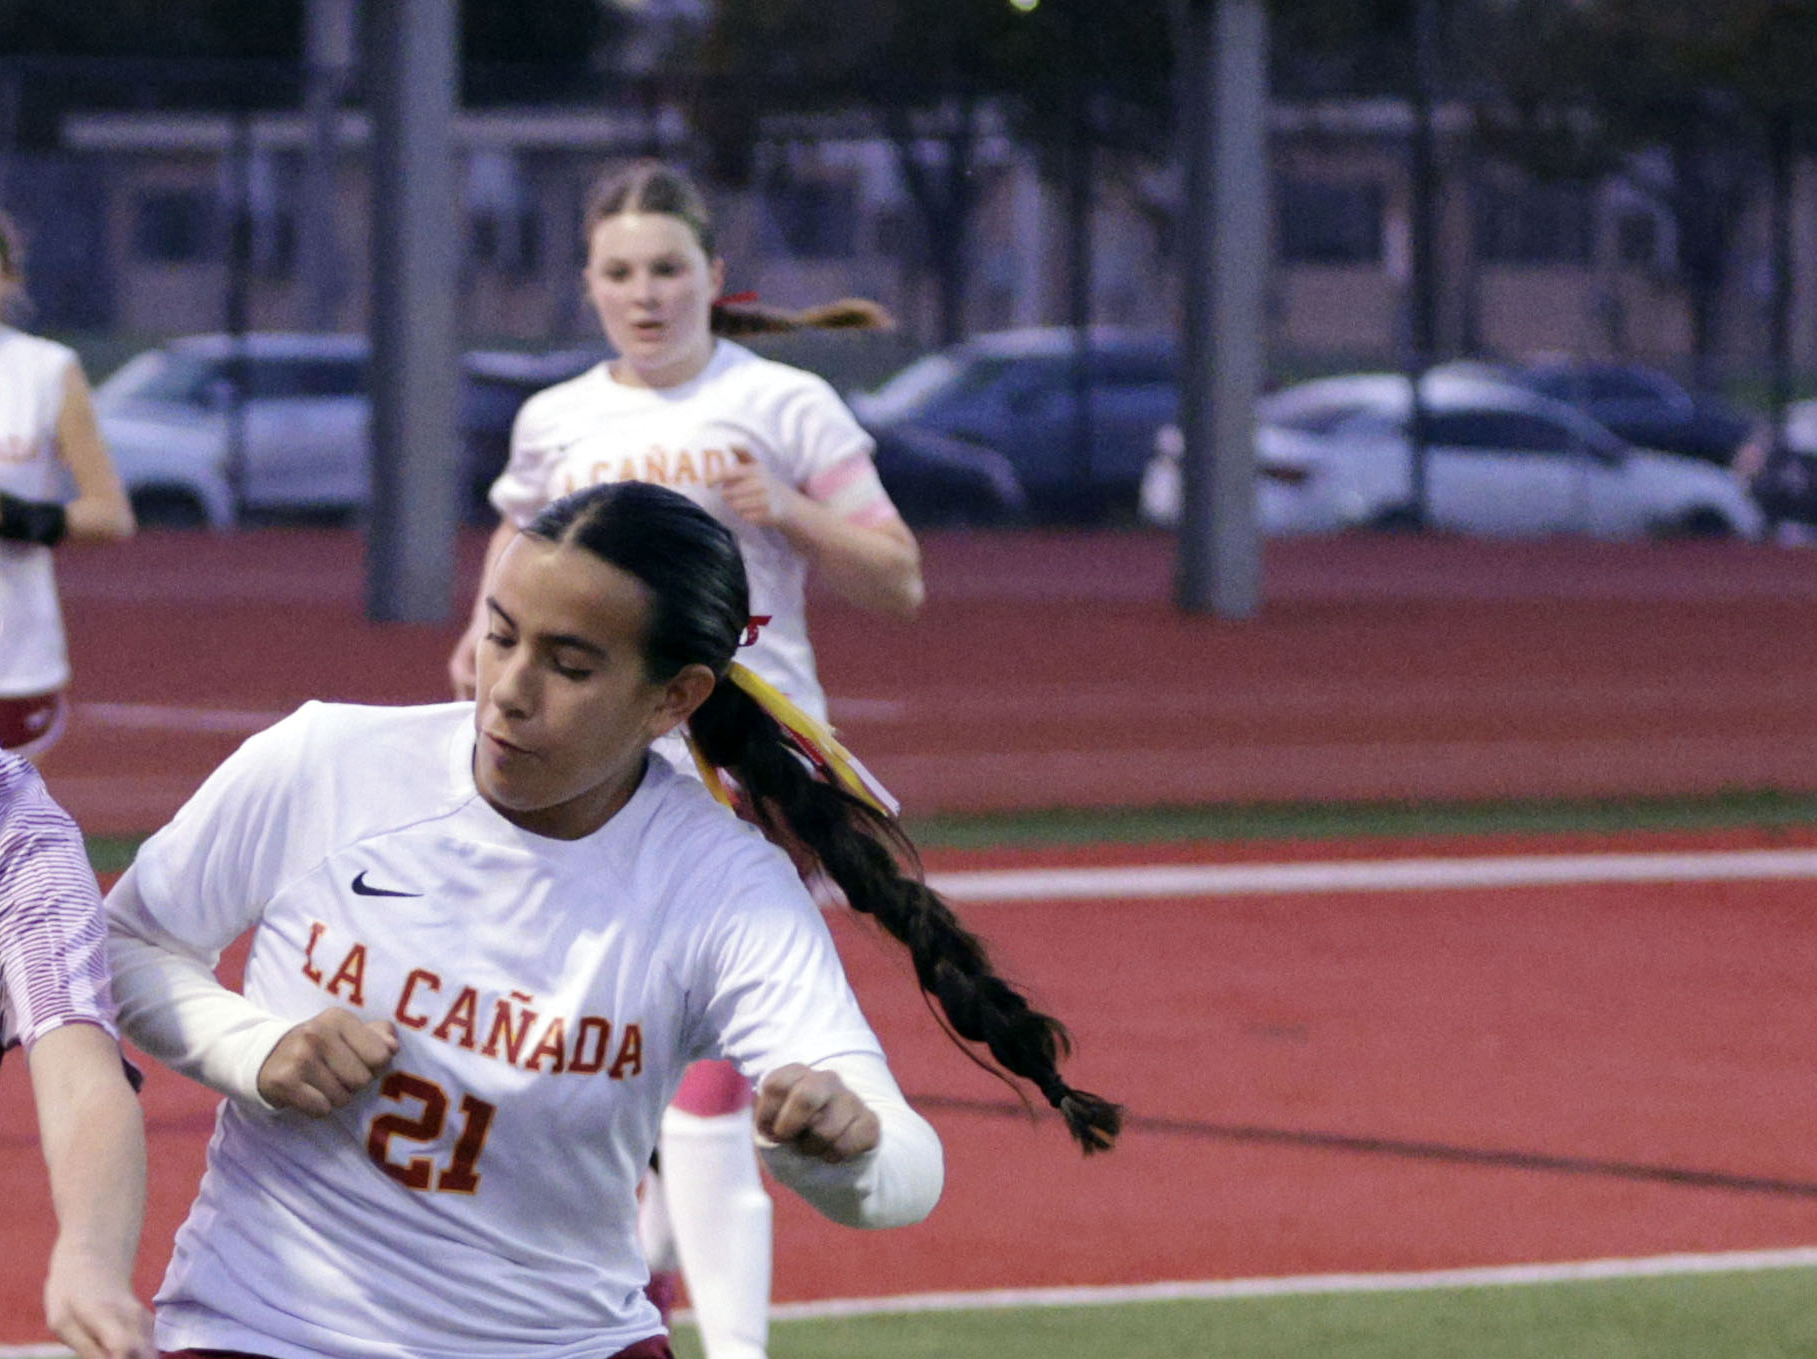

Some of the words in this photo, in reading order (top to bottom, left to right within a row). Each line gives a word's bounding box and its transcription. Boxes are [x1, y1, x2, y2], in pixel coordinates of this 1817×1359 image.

[301, 922, 369, 1007] LA
[394, 967, 644, 1080] CAÑADA
[366, 1070, 498, 1195] 21
